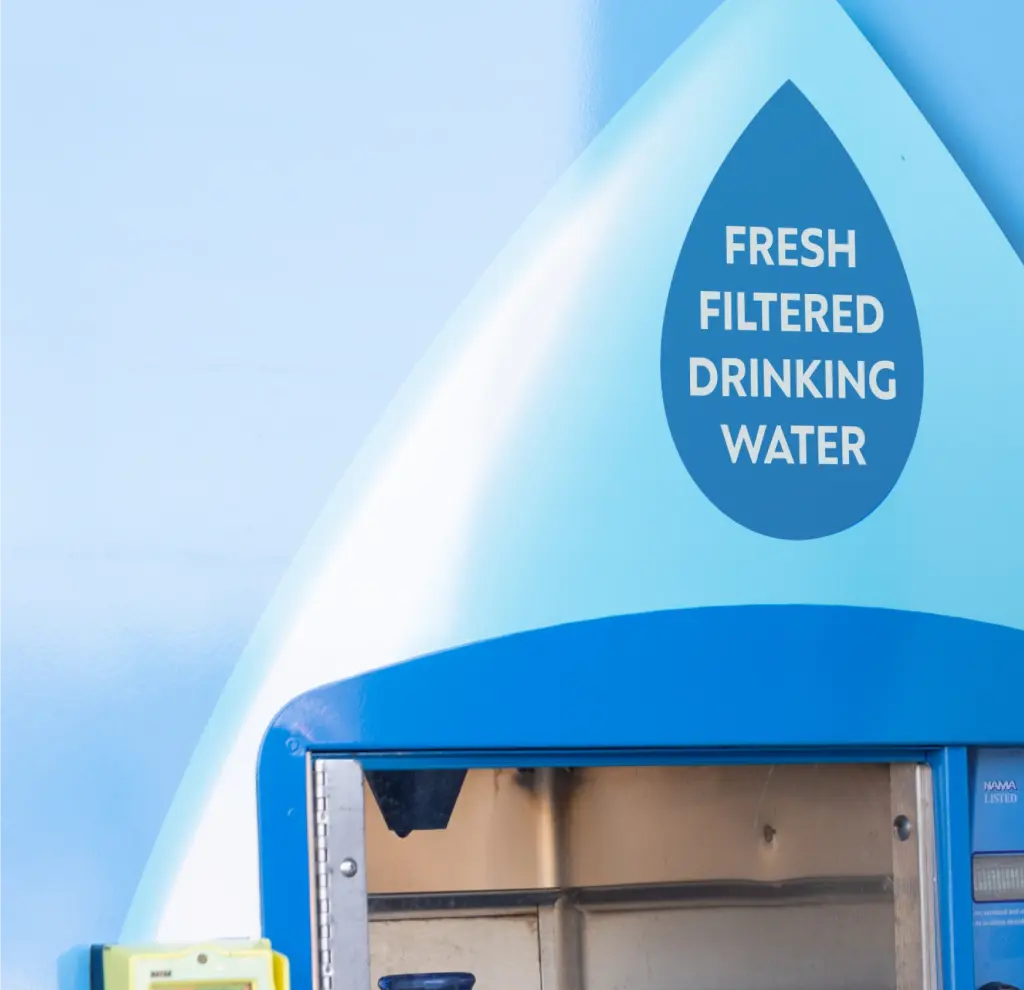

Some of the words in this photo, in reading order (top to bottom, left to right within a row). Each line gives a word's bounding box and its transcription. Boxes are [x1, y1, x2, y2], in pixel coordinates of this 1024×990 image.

[725, 225, 856, 268] FRESH
[700, 290, 885, 333] FILTERED
[689, 357, 897, 400] DRINKING
[720, 424, 867, 465] WATER
[984, 780, 1017, 790] NAMA
[984, 793, 1018, 803] LISTED
